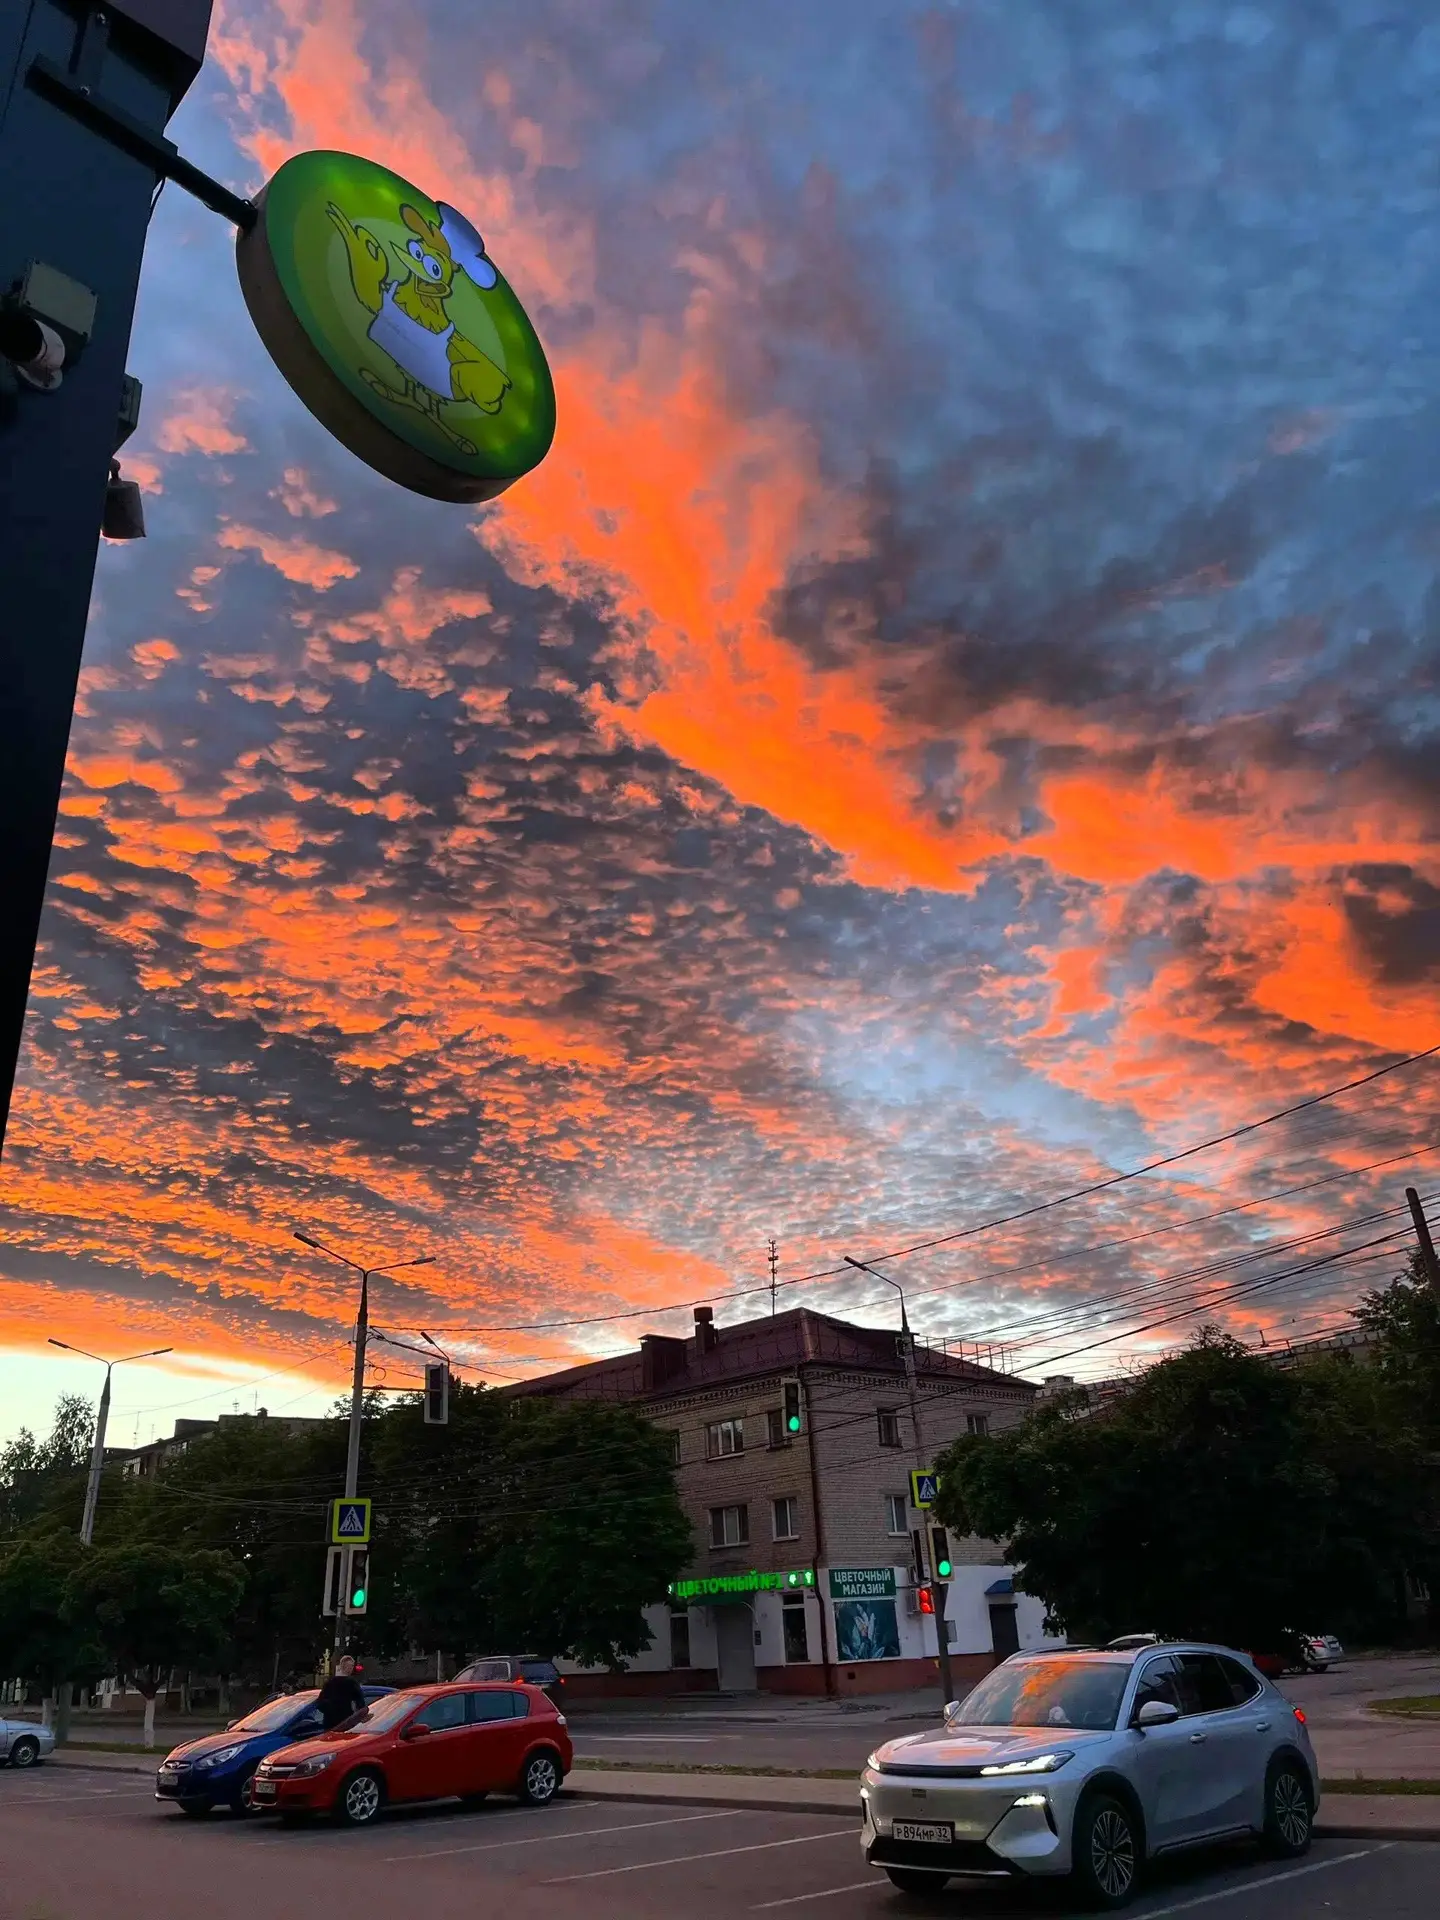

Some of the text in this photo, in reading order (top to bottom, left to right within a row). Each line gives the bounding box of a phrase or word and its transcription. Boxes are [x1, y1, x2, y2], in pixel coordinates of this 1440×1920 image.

[677, 1569, 759, 1597] ЦВЕТОЧНЫЙ
[834, 1568, 891, 1584] ЦВЕТОЧНЫЙ
[842, 1583, 886, 1596] МАГАЗИН
